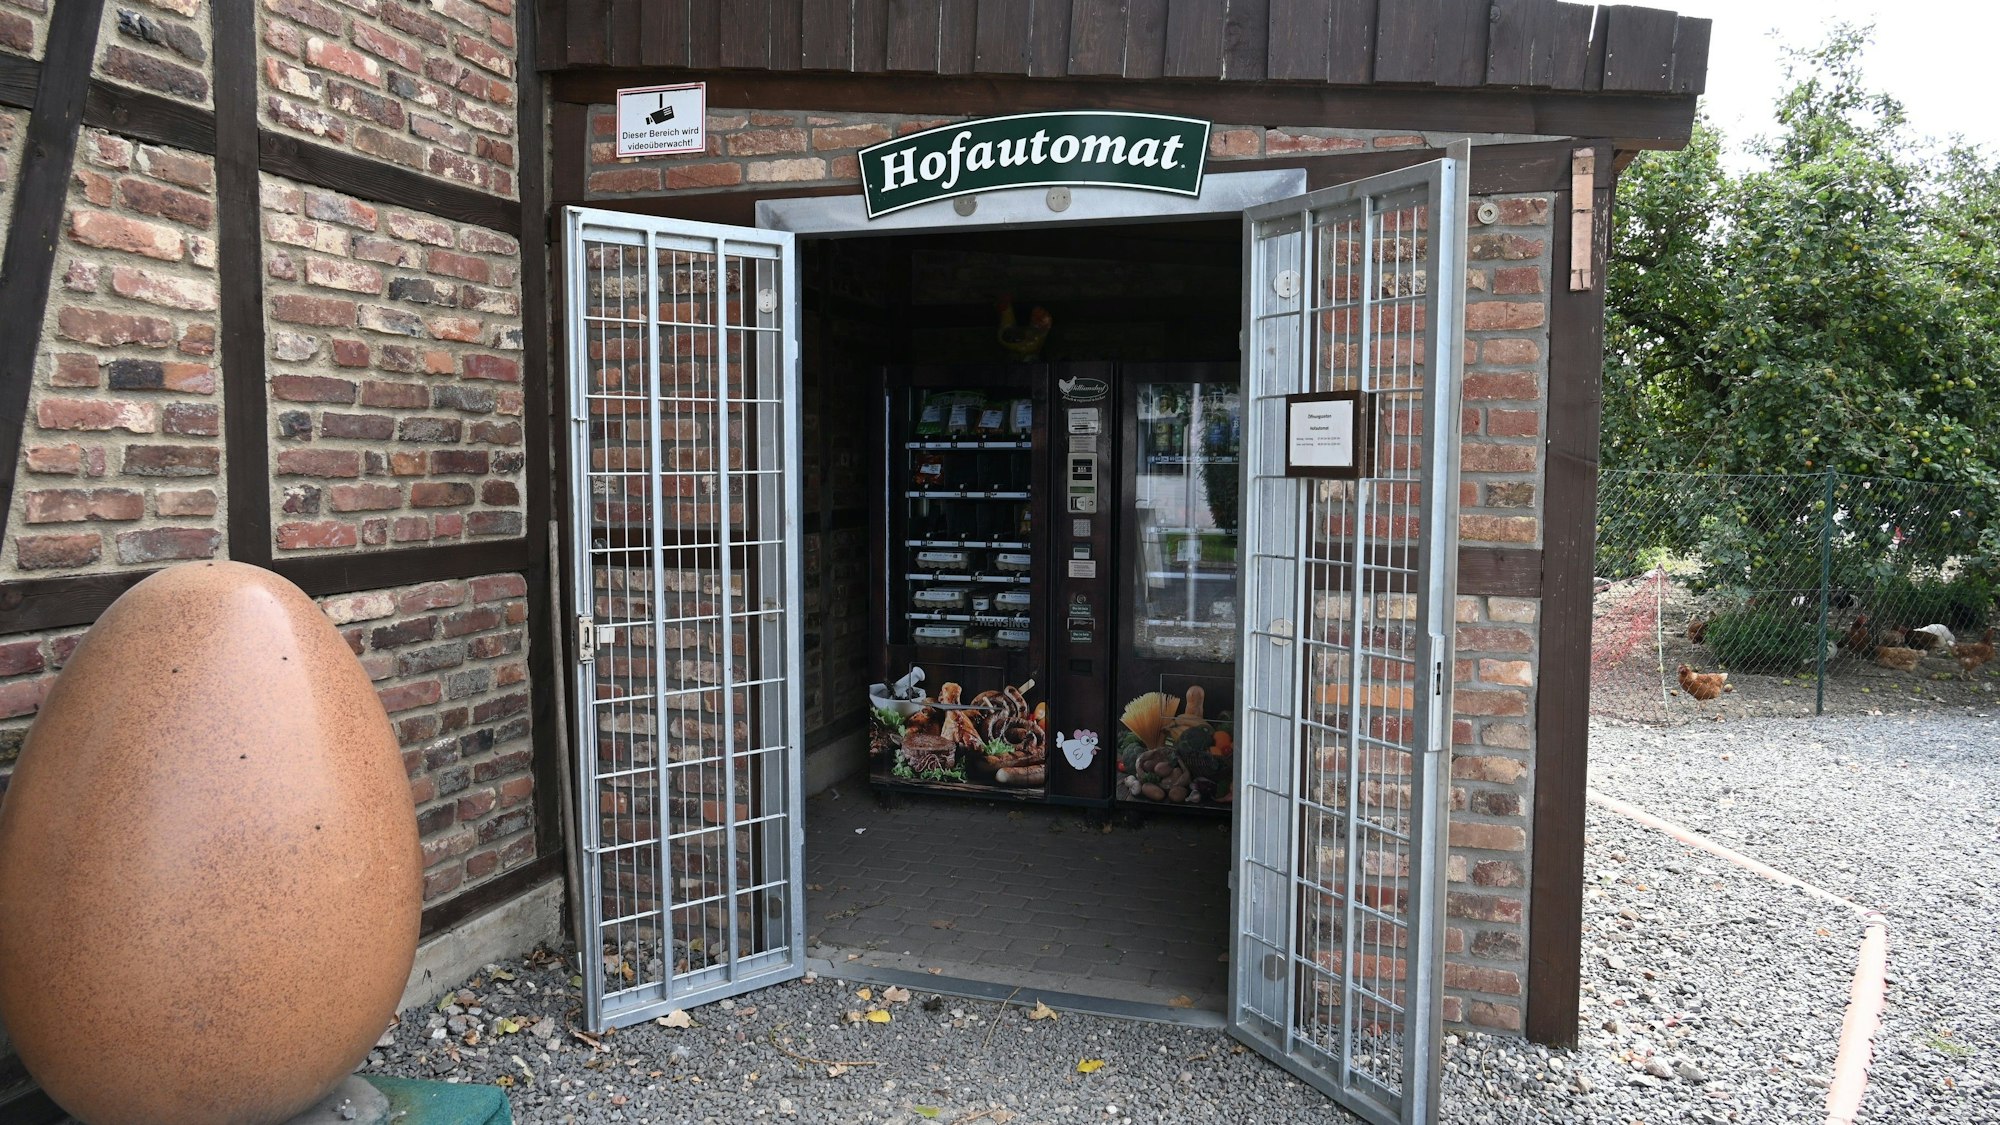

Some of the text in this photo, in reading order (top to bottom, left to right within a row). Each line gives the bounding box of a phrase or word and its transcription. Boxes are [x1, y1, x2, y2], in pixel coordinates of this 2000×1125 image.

[622, 126, 699, 140] Dieser Bereich wird
[627, 138, 693, 150] videoüberwacht!
[880, 129, 1184, 193] Hofautomat
